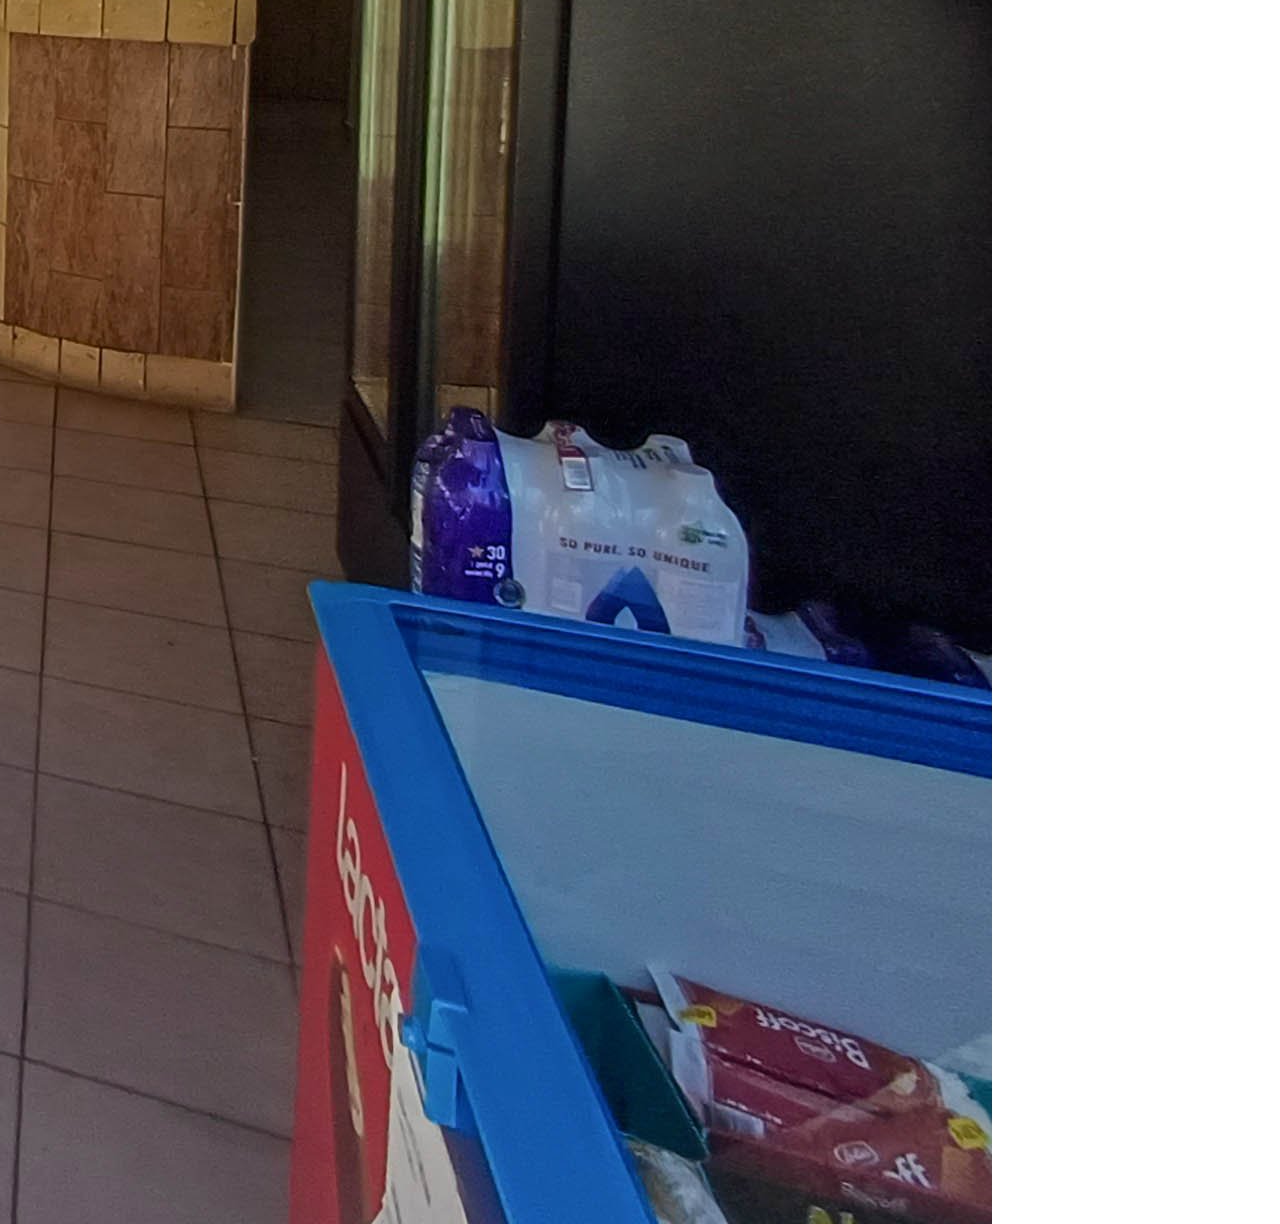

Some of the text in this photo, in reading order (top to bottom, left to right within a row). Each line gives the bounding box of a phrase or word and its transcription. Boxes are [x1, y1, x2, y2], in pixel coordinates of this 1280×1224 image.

[486, 545, 505, 560] 30
[560, 537, 578, 550] SO
[628, 546, 646, 558] SO
[653, 552, 710, 573] UNIQUE
[495, 562, 505, 578] 9
[753, 1007, 871, 1070] Biscoff
